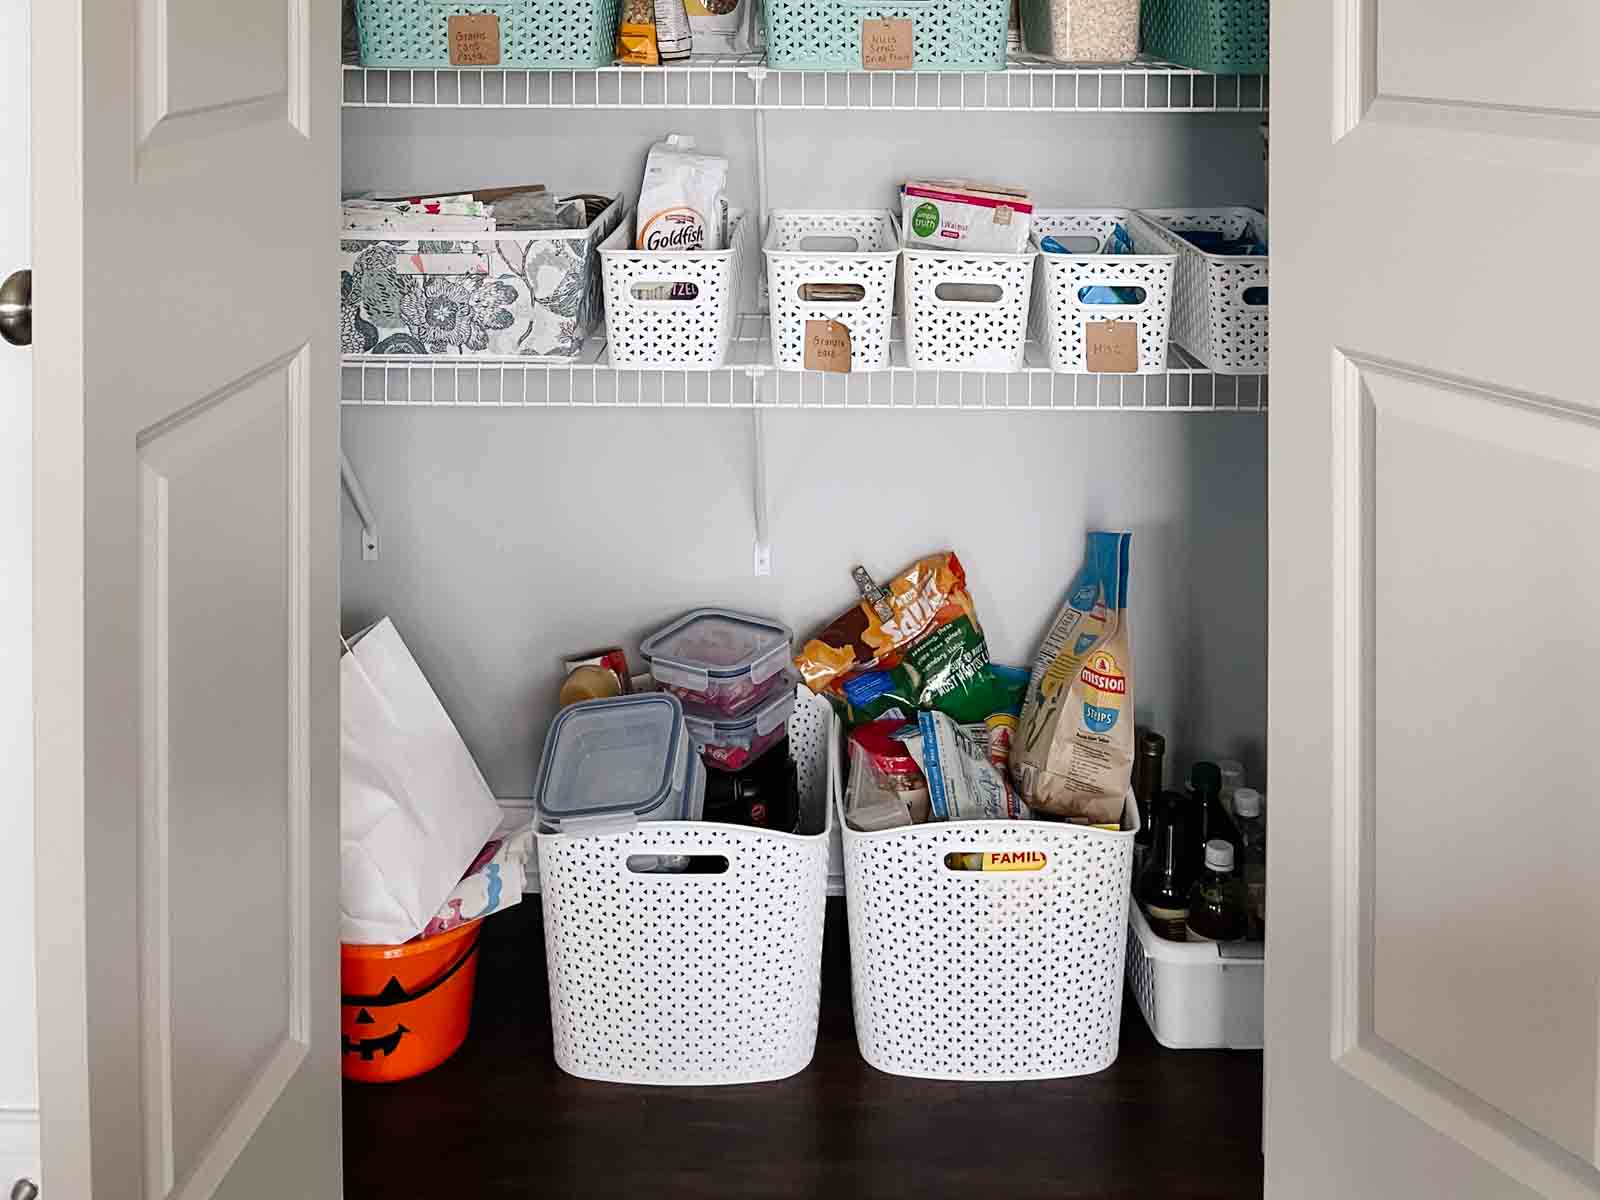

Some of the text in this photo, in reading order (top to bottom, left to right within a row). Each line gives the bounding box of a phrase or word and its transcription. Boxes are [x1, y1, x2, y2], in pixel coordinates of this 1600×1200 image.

[915, 218, 936, 229] truth
[648, 224, 705, 250] Goldfish
[672, 282, 698, 296] TZEL
